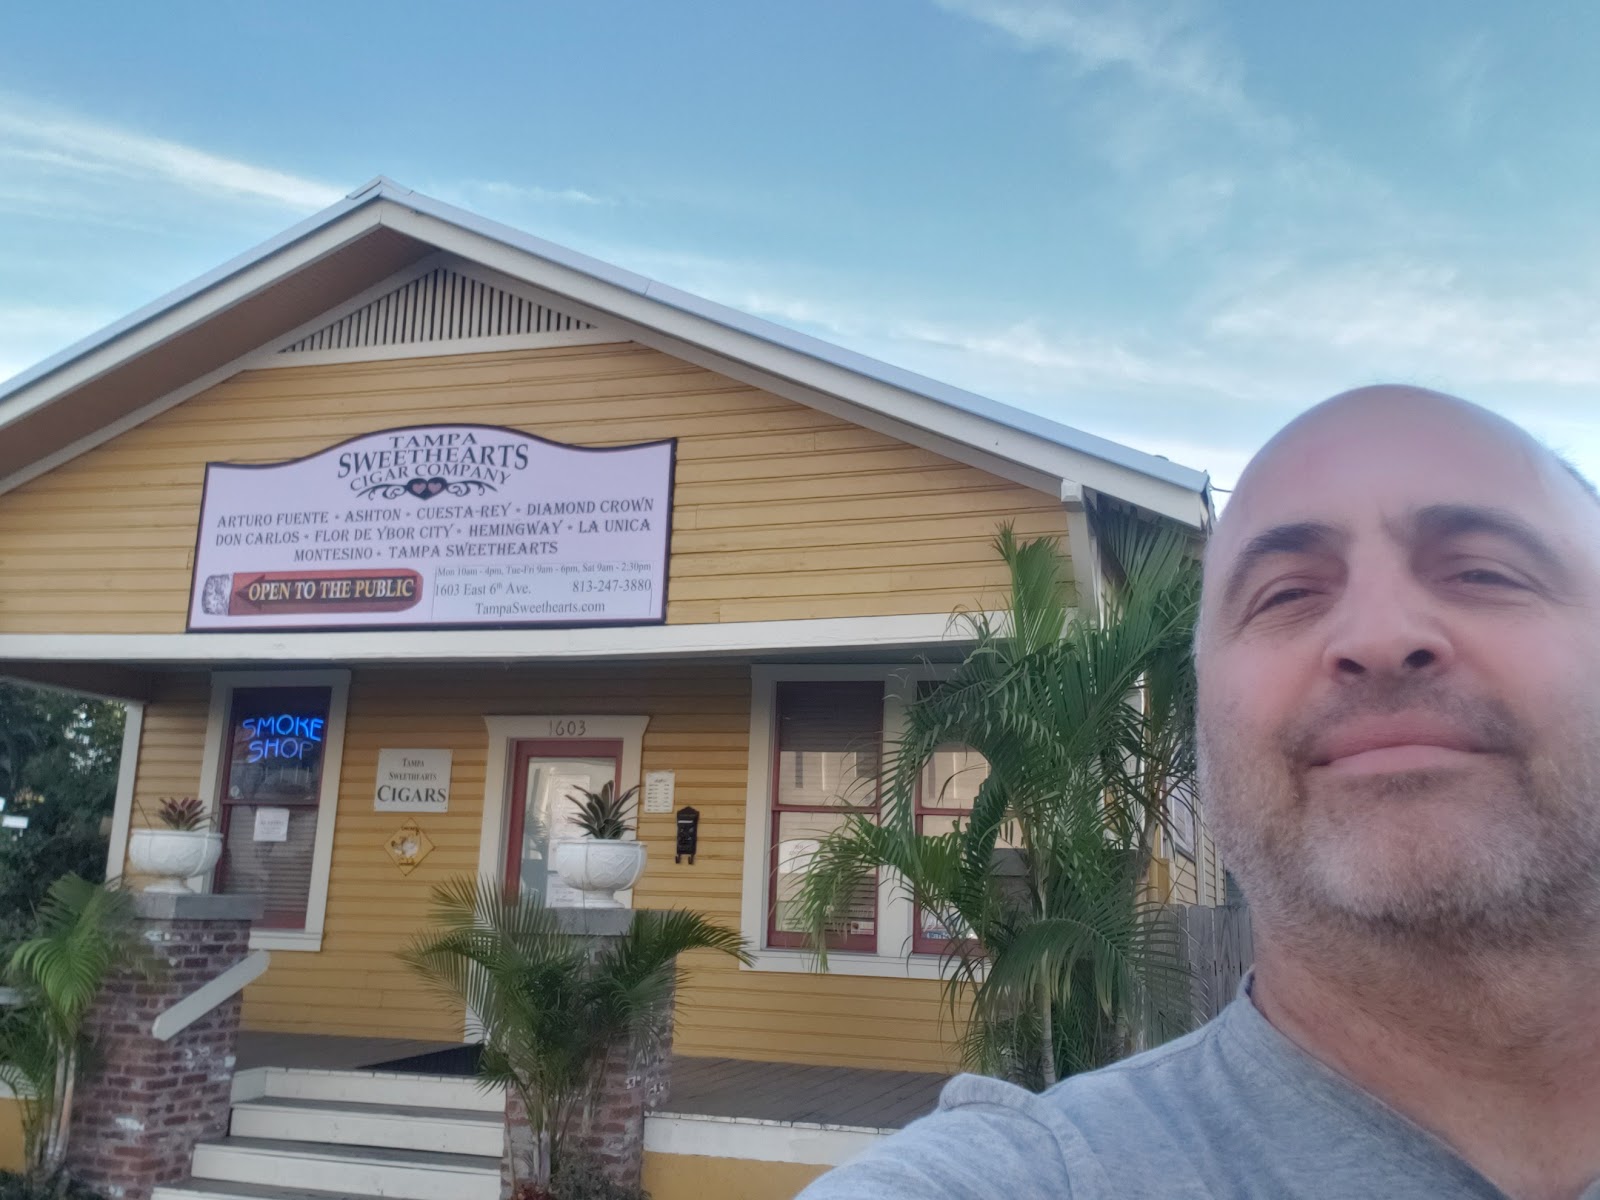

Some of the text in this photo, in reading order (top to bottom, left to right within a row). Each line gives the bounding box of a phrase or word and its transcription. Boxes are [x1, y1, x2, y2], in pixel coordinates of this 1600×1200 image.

[389, 432, 477, 449] TAMPA
[337, 443, 529, 479] SWEETHEARTS
[350, 463, 511, 492] CIGAR COMPANY
[216, 497, 654, 529] ARTURO FUENTE ASHTON CUESTA-REY DIAMOND CROWN
[215, 518, 652, 547] DON CARLOS FLOR DE YBOR CITY HEMINGWAY LA UNICA
[293, 541, 560, 563] MONTESINO TAMPA SWEETHEARTS
[437, 567, 455, 577] Mon
[457, 566, 478, 577] 10am
[484, 566, 504, 577] 4pm,
[506, 564, 535, 576] Tue-Fri
[536, 564, 554, 575] 9am
[560, 564, 580, 575] 6pm,
[582, 562, 595, 573] Sat
[596, 562, 614, 573] 9am
[248, 579, 415, 602] OPEN TO THE PUBLIC
[435, 583, 460, 597] 1603
[463, 583, 486, 596] East
[505, 582, 532, 595] Ave.
[572, 578, 652, 593] 813-247-3880
[475, 600, 605, 617] TampaSweethearts.com
[242, 714, 324, 741] SMOKE
[550, 719, 587, 736] 1603
[247, 737, 314, 763] SHOP
[377, 784, 447, 803] CIGARS
